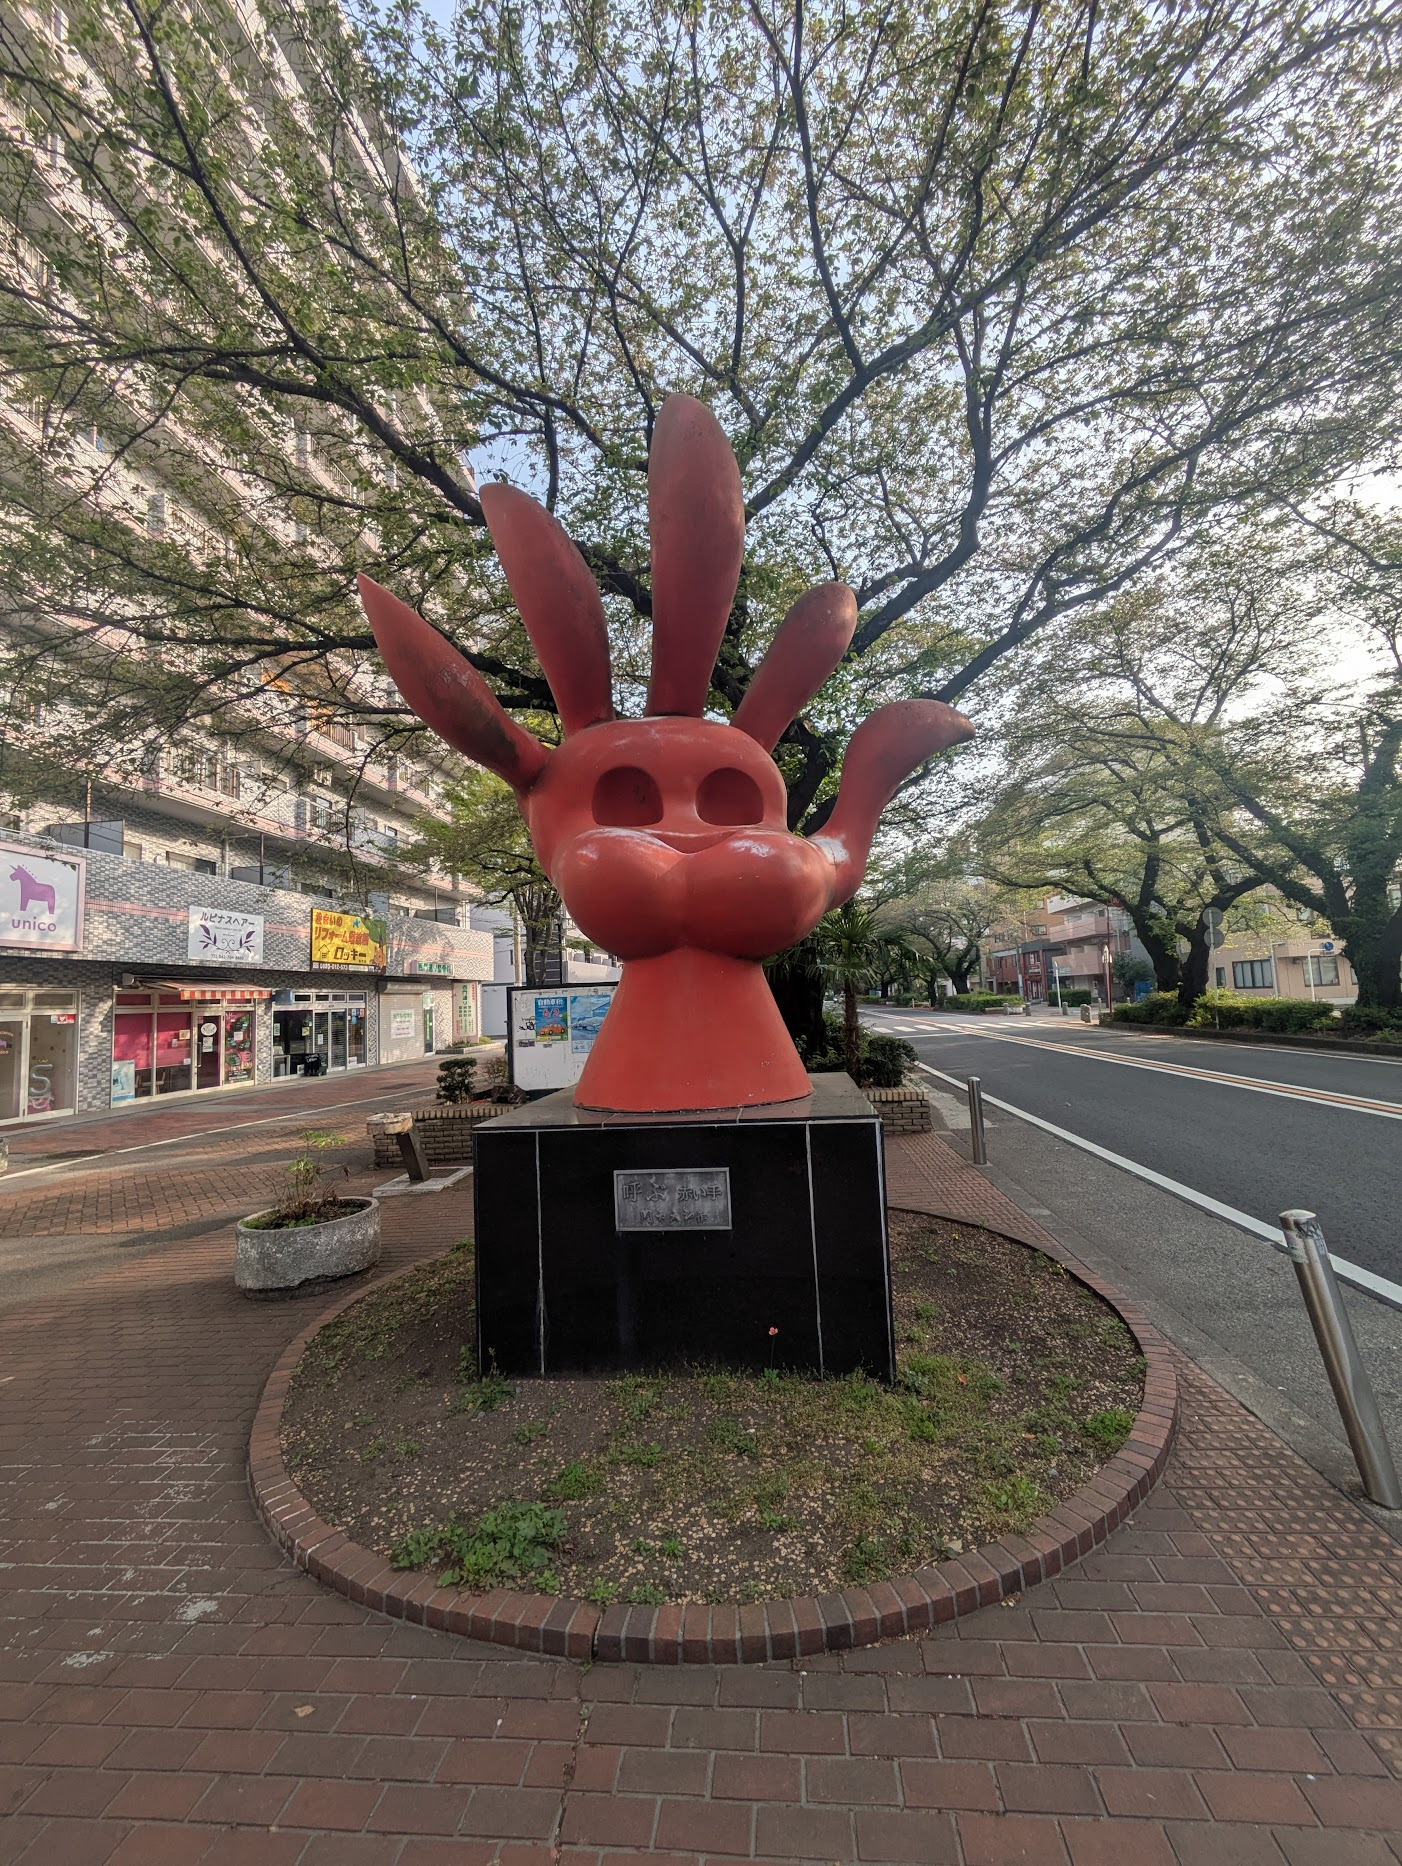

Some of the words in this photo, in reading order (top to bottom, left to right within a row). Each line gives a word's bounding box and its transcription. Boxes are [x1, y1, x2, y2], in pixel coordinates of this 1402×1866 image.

[11, 916, 57, 932] unico
[199, 911, 255, 927] ルピナスヘアー
[333, 946, 367, 961] ロッキー
[622, 1180, 723, 1203] 呼ぶ赤い手
